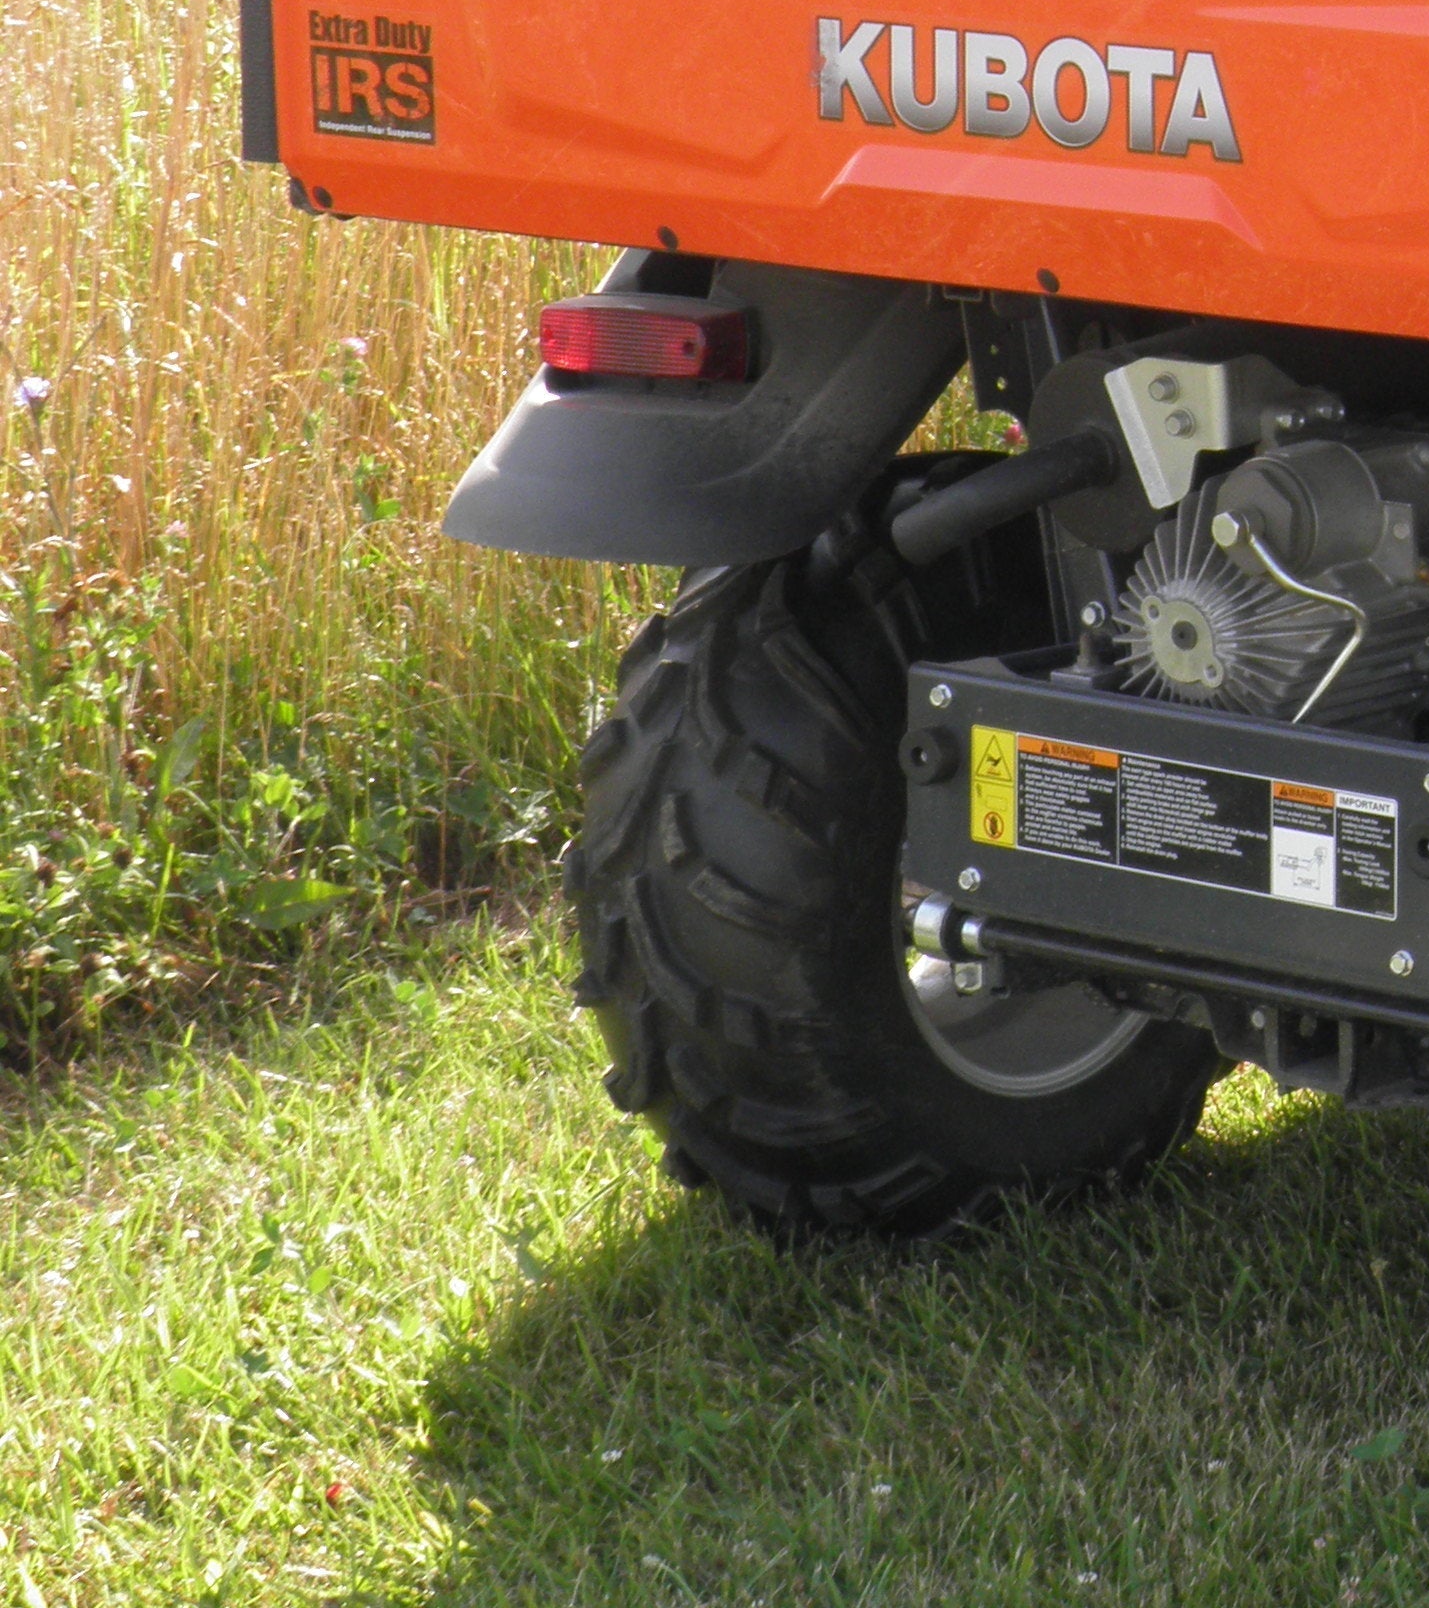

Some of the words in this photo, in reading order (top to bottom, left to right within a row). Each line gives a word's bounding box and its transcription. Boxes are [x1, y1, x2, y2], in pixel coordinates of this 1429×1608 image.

[310, 10, 369, 46] Extra
[375, 16, 432, 54] Duty
[314, 53, 431, 120] IRS
[816, 16, 1244, 163] KUBOTA
[319, 120, 366, 134] Independent
[367, 124, 385, 135] Rear
[387, 126, 432, 140] Suspension
[1052, 744, 1096, 762] WARNING
[1289, 788, 1328, 803] WARNING
[1339, 796, 1391, 813] IMPORTANT
